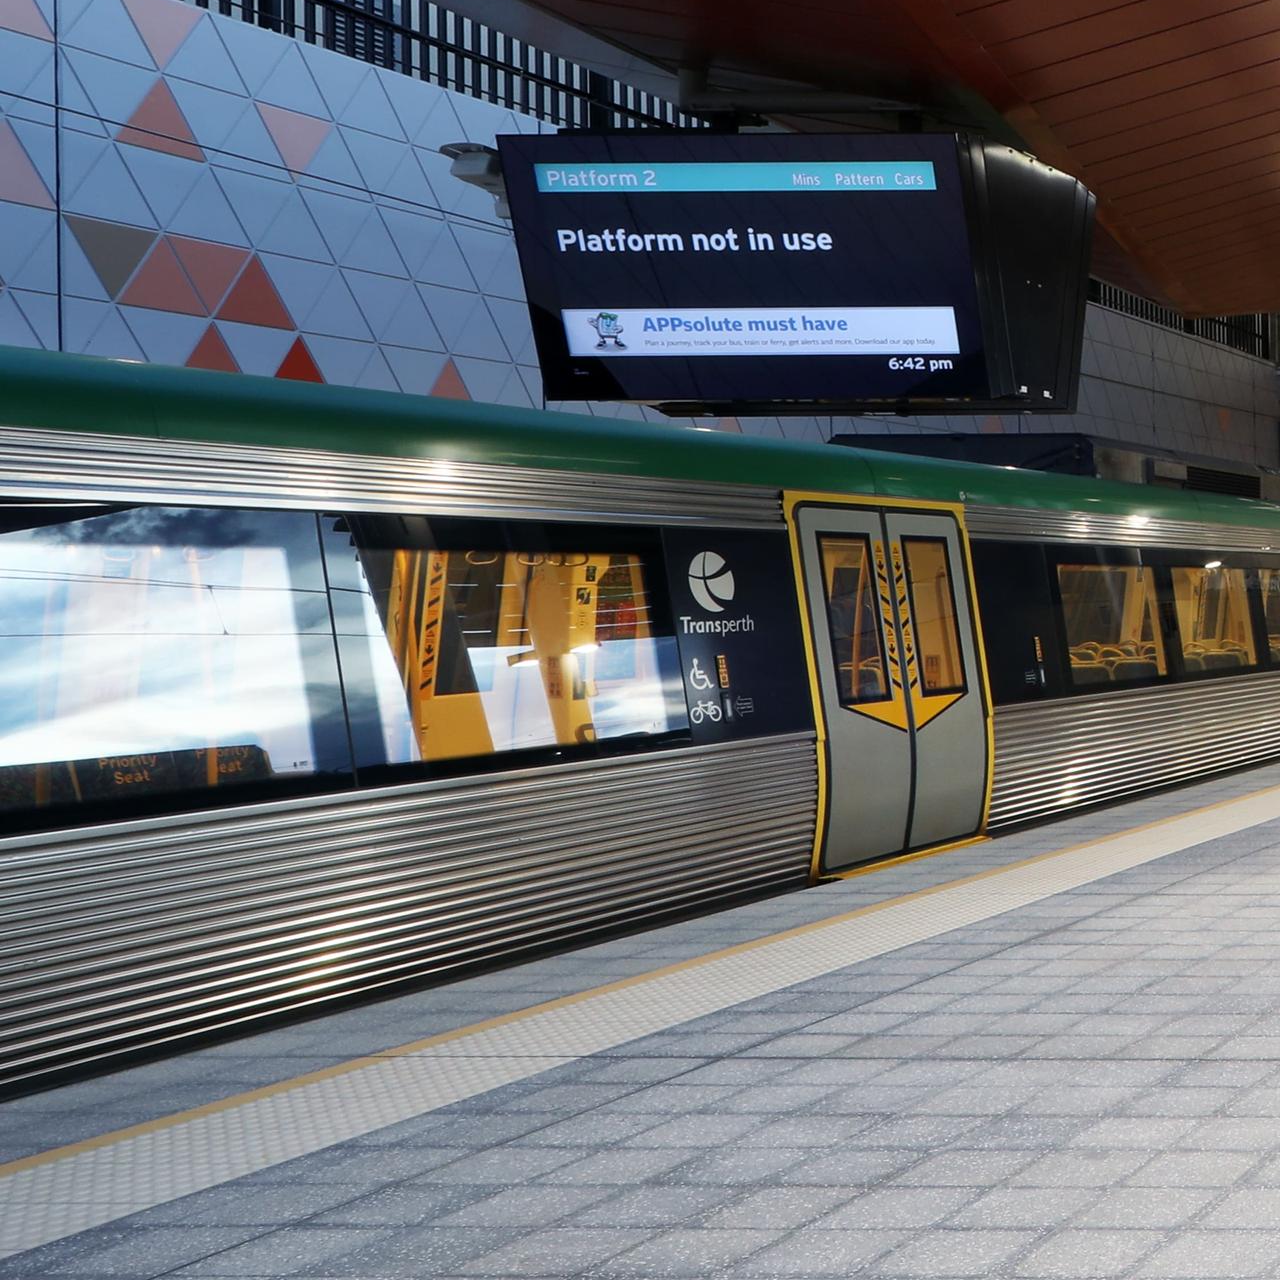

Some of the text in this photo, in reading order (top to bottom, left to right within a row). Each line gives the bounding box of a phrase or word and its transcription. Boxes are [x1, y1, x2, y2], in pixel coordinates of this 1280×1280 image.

[546, 170, 657, 187] Platform 2
[792, 172, 923, 186] Mins Pattern Cars
[557, 227, 833, 253] Platform not in use
[642, 315, 849, 333] APPsolute must have
[888, 357, 953, 372] 6:42 pm
[679, 615, 755, 637] Transperth
[99, 755, 158, 770] Priority
[114, 760, 242, 785] Seat eat
